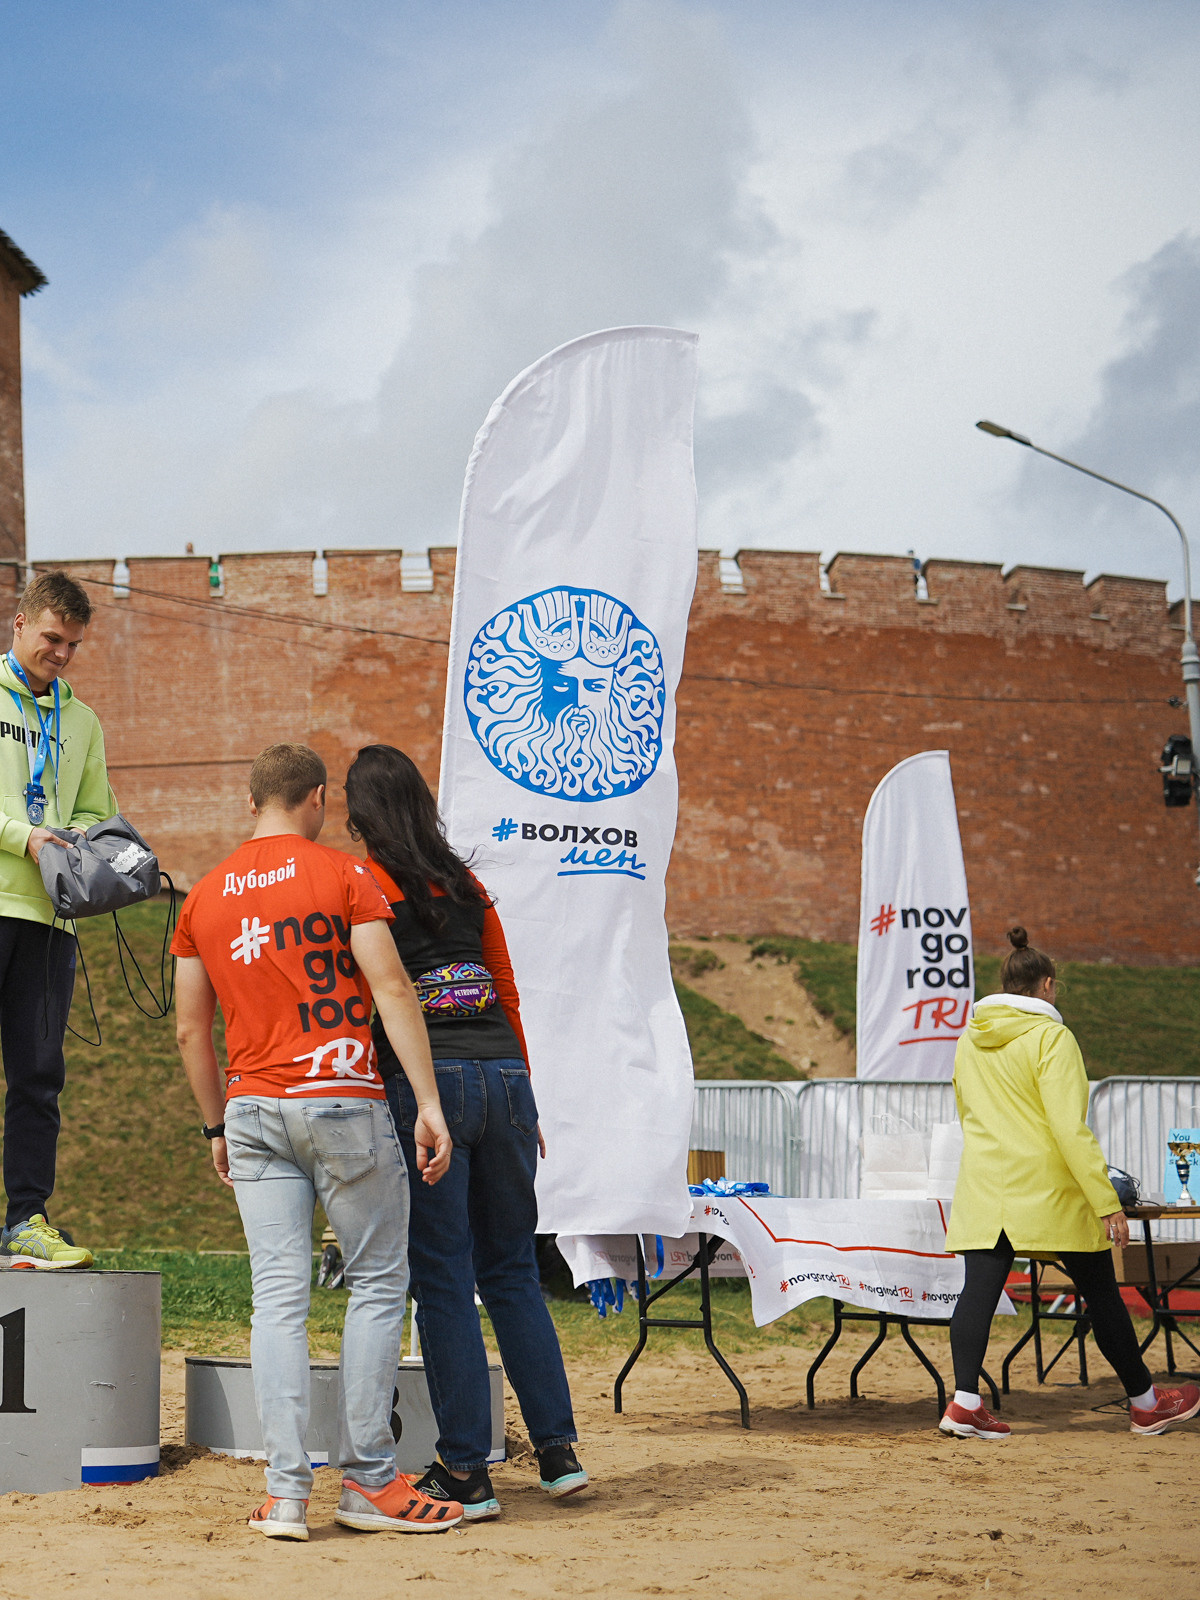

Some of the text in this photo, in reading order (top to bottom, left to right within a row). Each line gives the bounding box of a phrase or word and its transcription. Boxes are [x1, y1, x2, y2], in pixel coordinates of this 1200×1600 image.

[0, 721, 42, 749] PUM
[560, 846, 647, 870] мен
[222, 857, 296, 897] Дубовой
[870, 904, 968, 936] #nov
[230, 911, 351, 965] #nov
[921, 932, 969, 963] go
[303, 949, 356, 995] go
[907, 955, 970, 989] rod
[902, 997, 970, 1030] TRI
[293, 1037, 376, 1080] TRI
